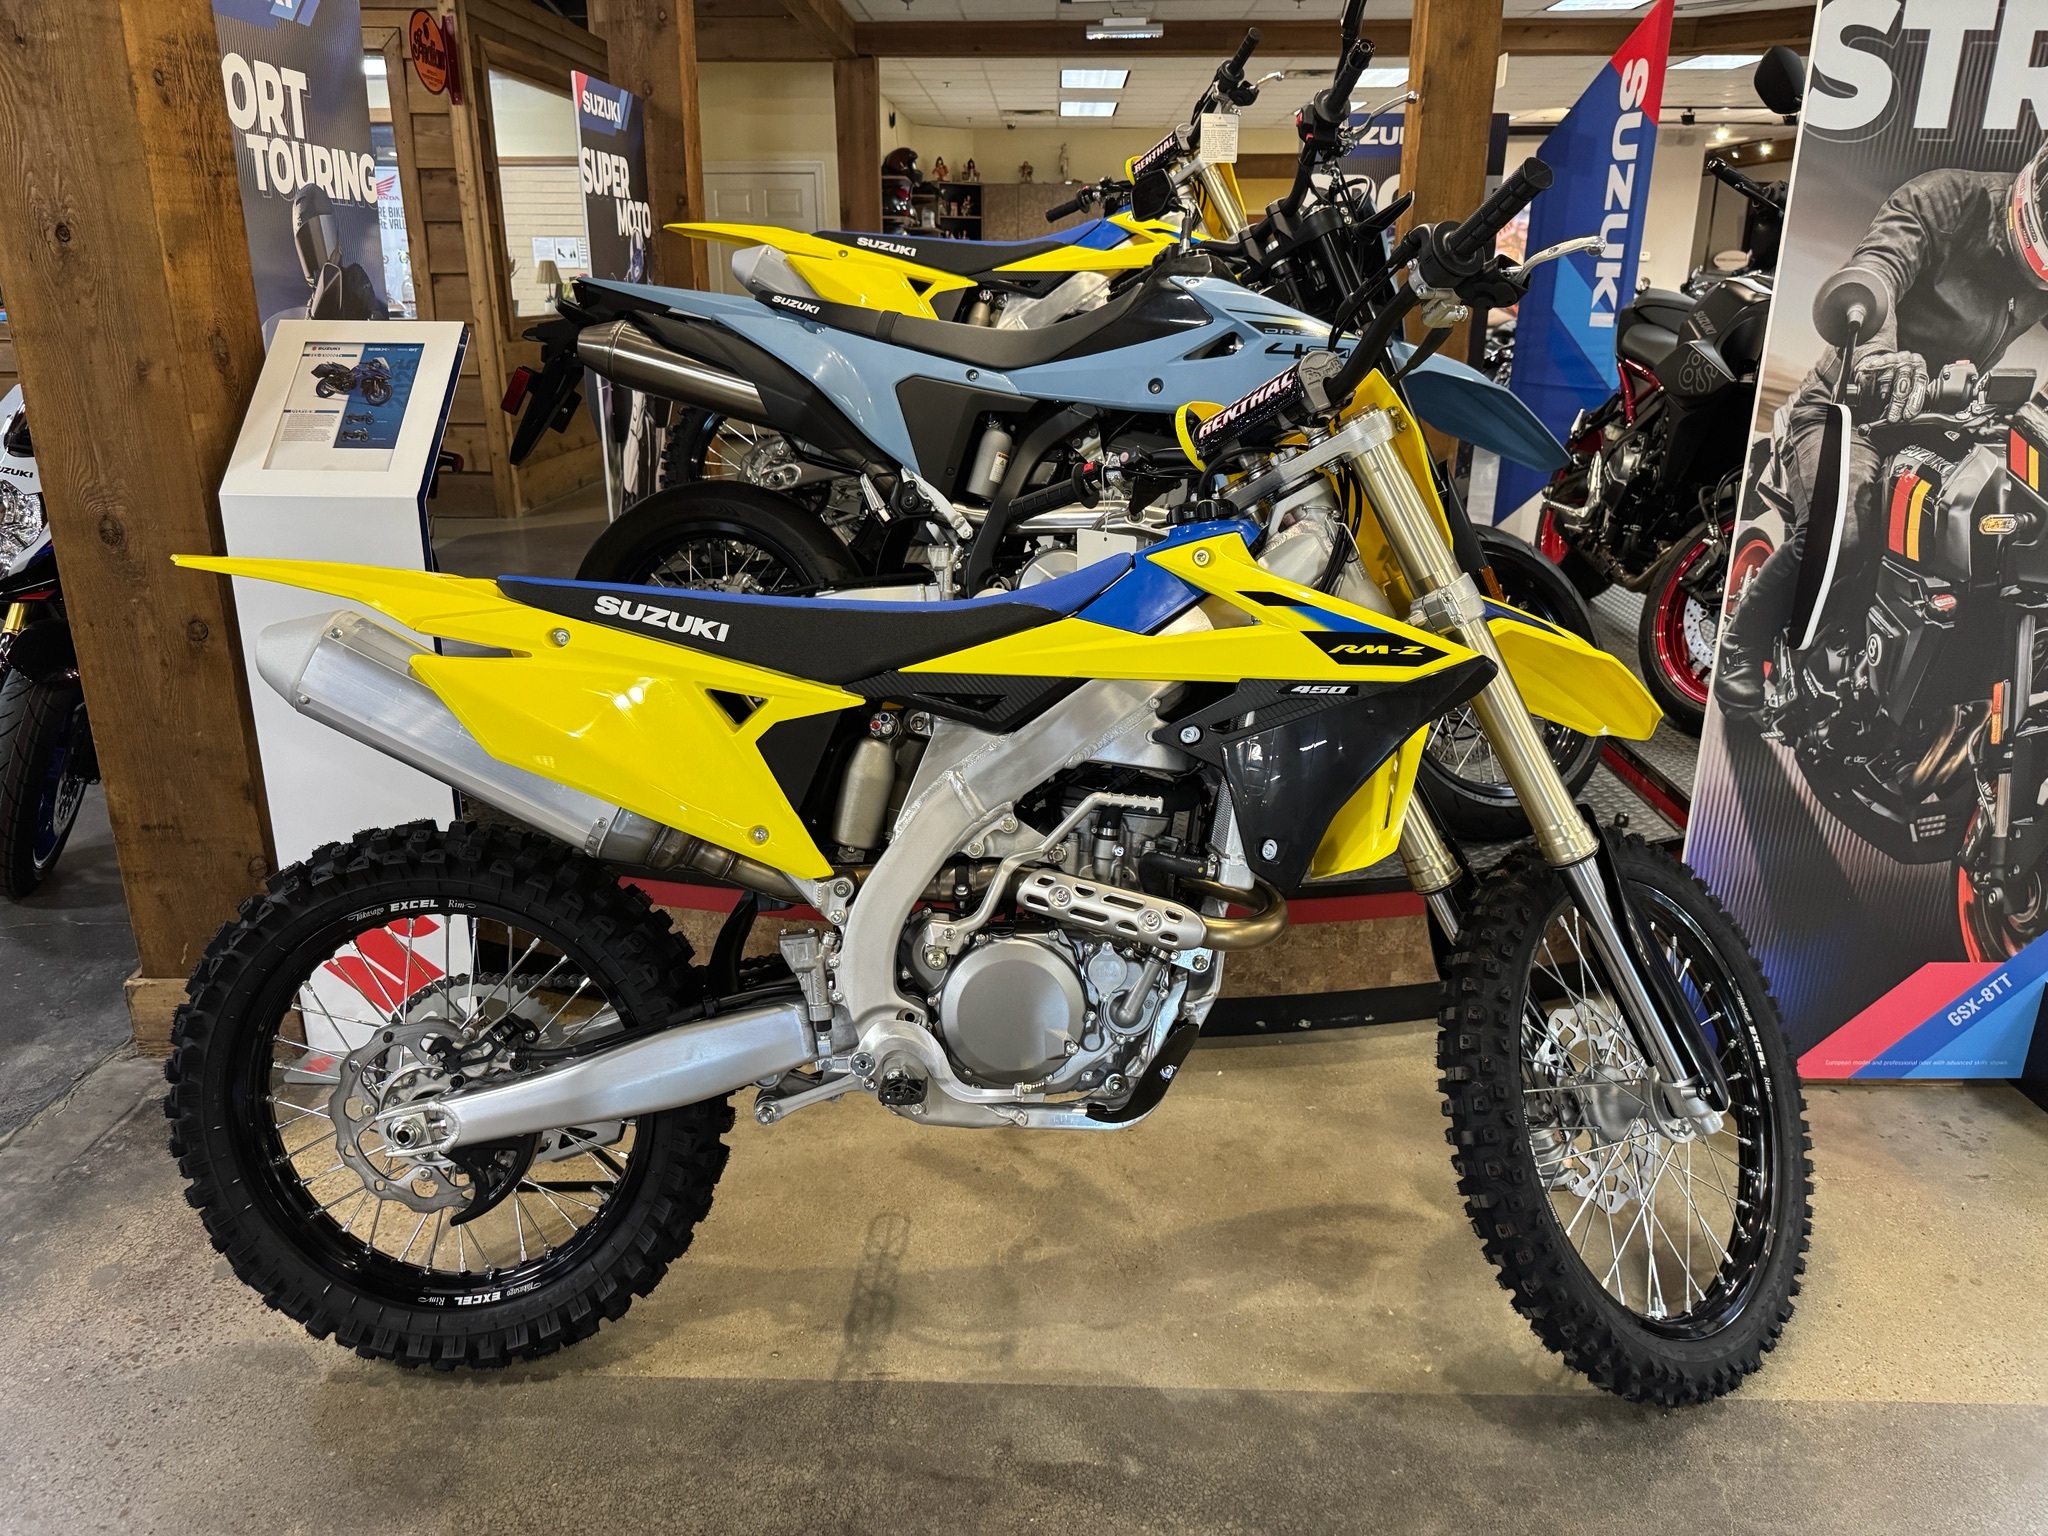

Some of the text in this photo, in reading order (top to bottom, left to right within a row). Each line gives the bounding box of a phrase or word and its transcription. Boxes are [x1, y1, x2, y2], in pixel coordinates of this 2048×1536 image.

[581, 89, 622, 124] SUZUKI
[1358, 126, 1404, 146] ZU
[246, 133, 377, 204] TOURING
[1133, 136, 1176, 174] RENTHAL
[581, 146, 631, 199] SUPER
[1588, 57, 1650, 328] SUZUKI
[615, 198, 651, 239] MOTO
[856, 237, 917, 257] SUZUKI
[771, 295, 821, 315] SUZUKI
[1693, 310, 1717, 335] SUZUKI
[1198, 372, 1293, 439] RENTHAL
[1899, 444, 1955, 474] SUZUKI
[594, 595, 730, 643] SUZUKI
[1328, 644, 1425, 656] RM-Z
[1290, 685, 1351, 695] 450
[352, 899, 466, 921] Takasago EXCEL Rim
[1947, 972, 2013, 1027] GSX-8TT
[1748, 1024, 1767, 1069] EXCEL
[1825, 1059, 1852, 1067] European
[1883, 1059, 1918, 1067] professional
[428, 1296, 446, 1306] Rim
[454, 1290, 502, 1306] EXCEL
